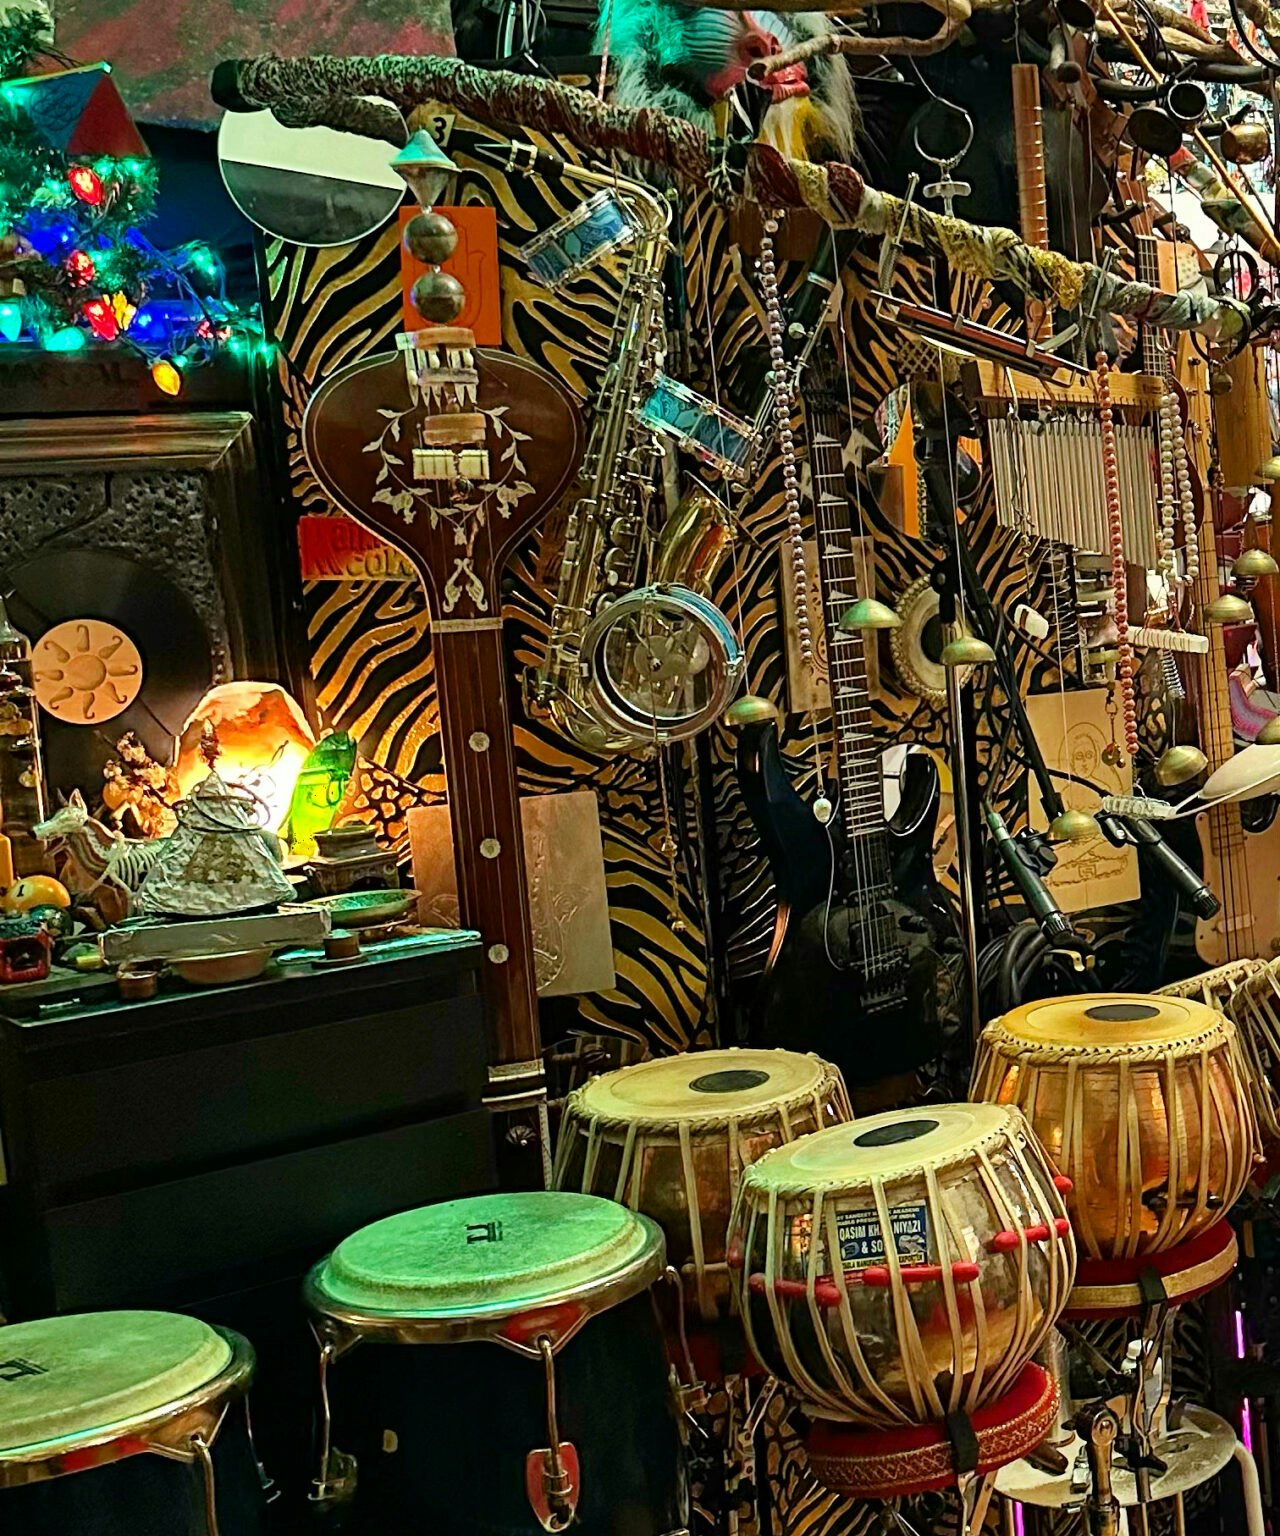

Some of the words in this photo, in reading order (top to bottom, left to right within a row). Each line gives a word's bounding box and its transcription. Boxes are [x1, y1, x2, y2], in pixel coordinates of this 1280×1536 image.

[433, 116, 447, 145] 3
[16, 884, 25, 897] 1
[840, 1224, 866, 1241] QASIM
[868, 1222, 882, 1237] KH
[893, 1219, 921, 1234] NIYAZI
[861, 1240, 869, 1254] &
[871, 1239, 884, 1253] SO
